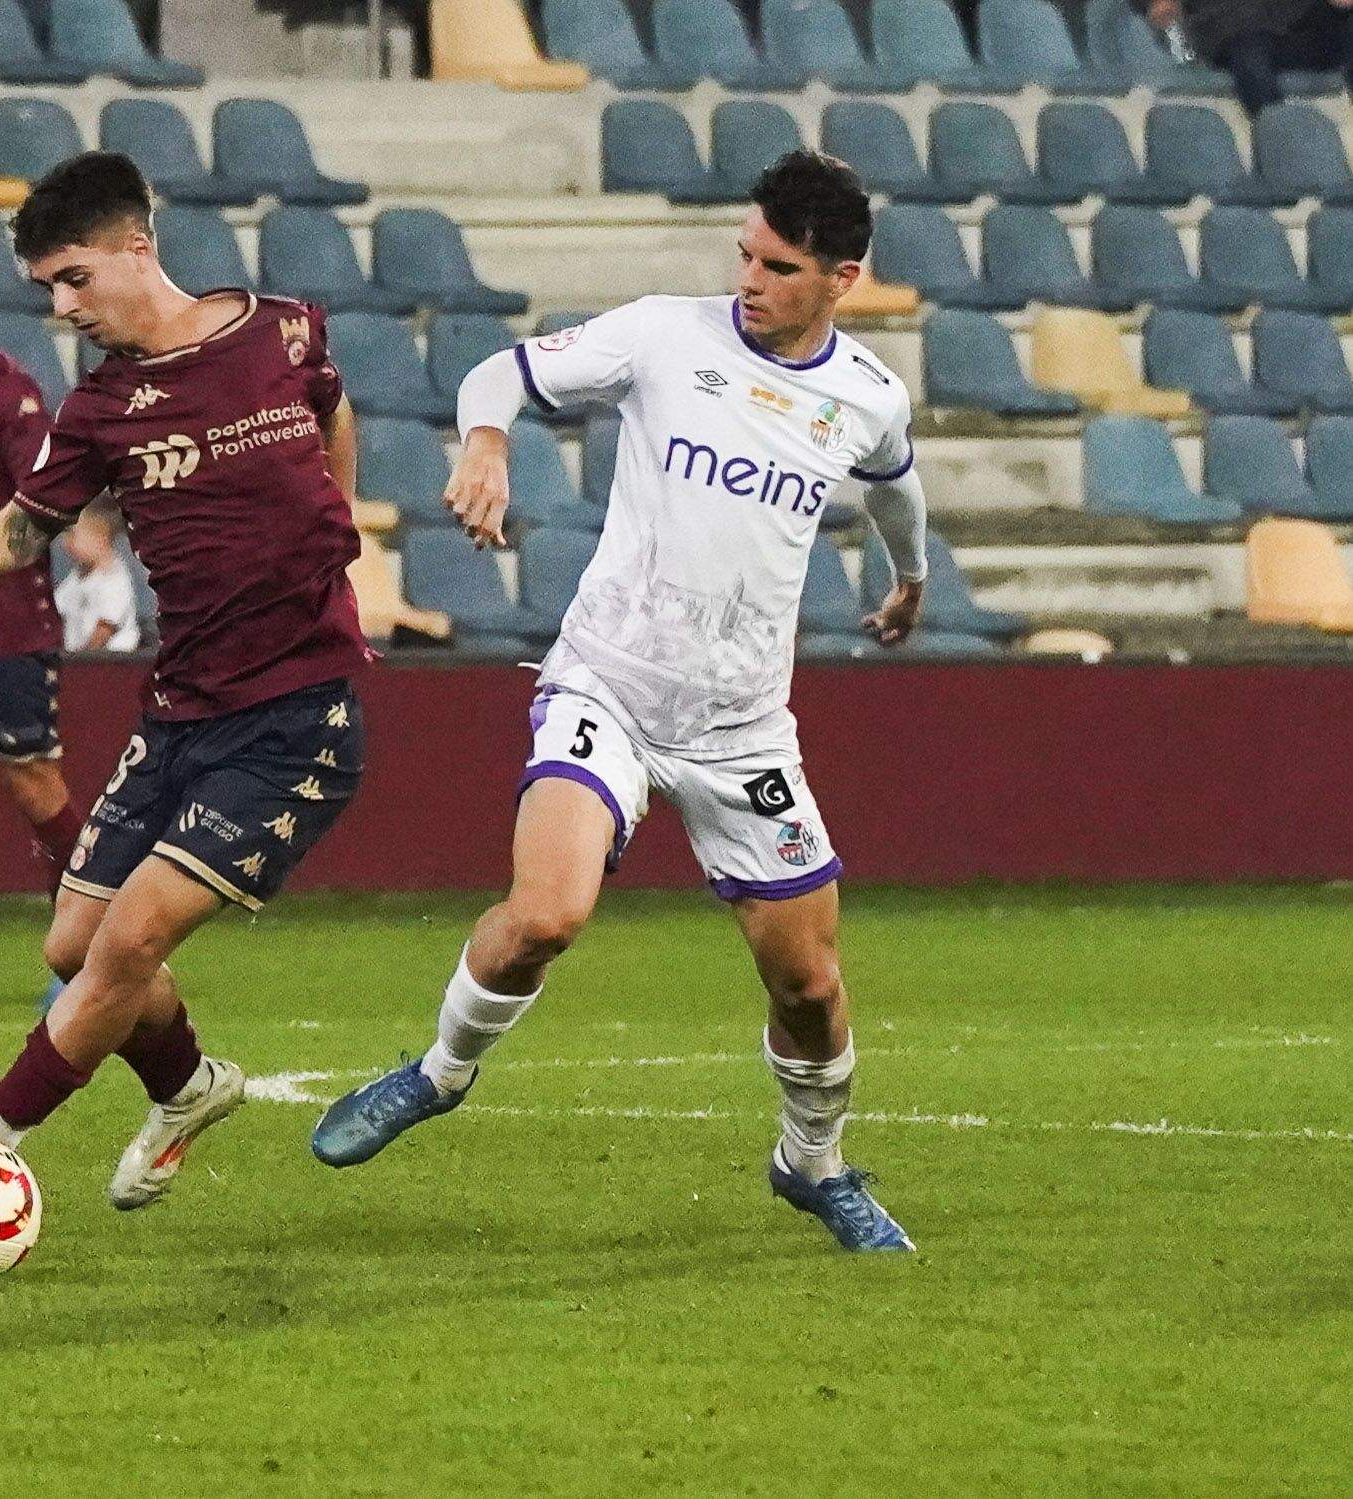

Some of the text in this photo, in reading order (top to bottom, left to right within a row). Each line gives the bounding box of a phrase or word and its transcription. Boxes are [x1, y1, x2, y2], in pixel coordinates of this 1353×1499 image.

[210, 420, 316, 460] Pontevedra
[664, 435, 827, 516] meins
[569, 717, 598, 760] 5
